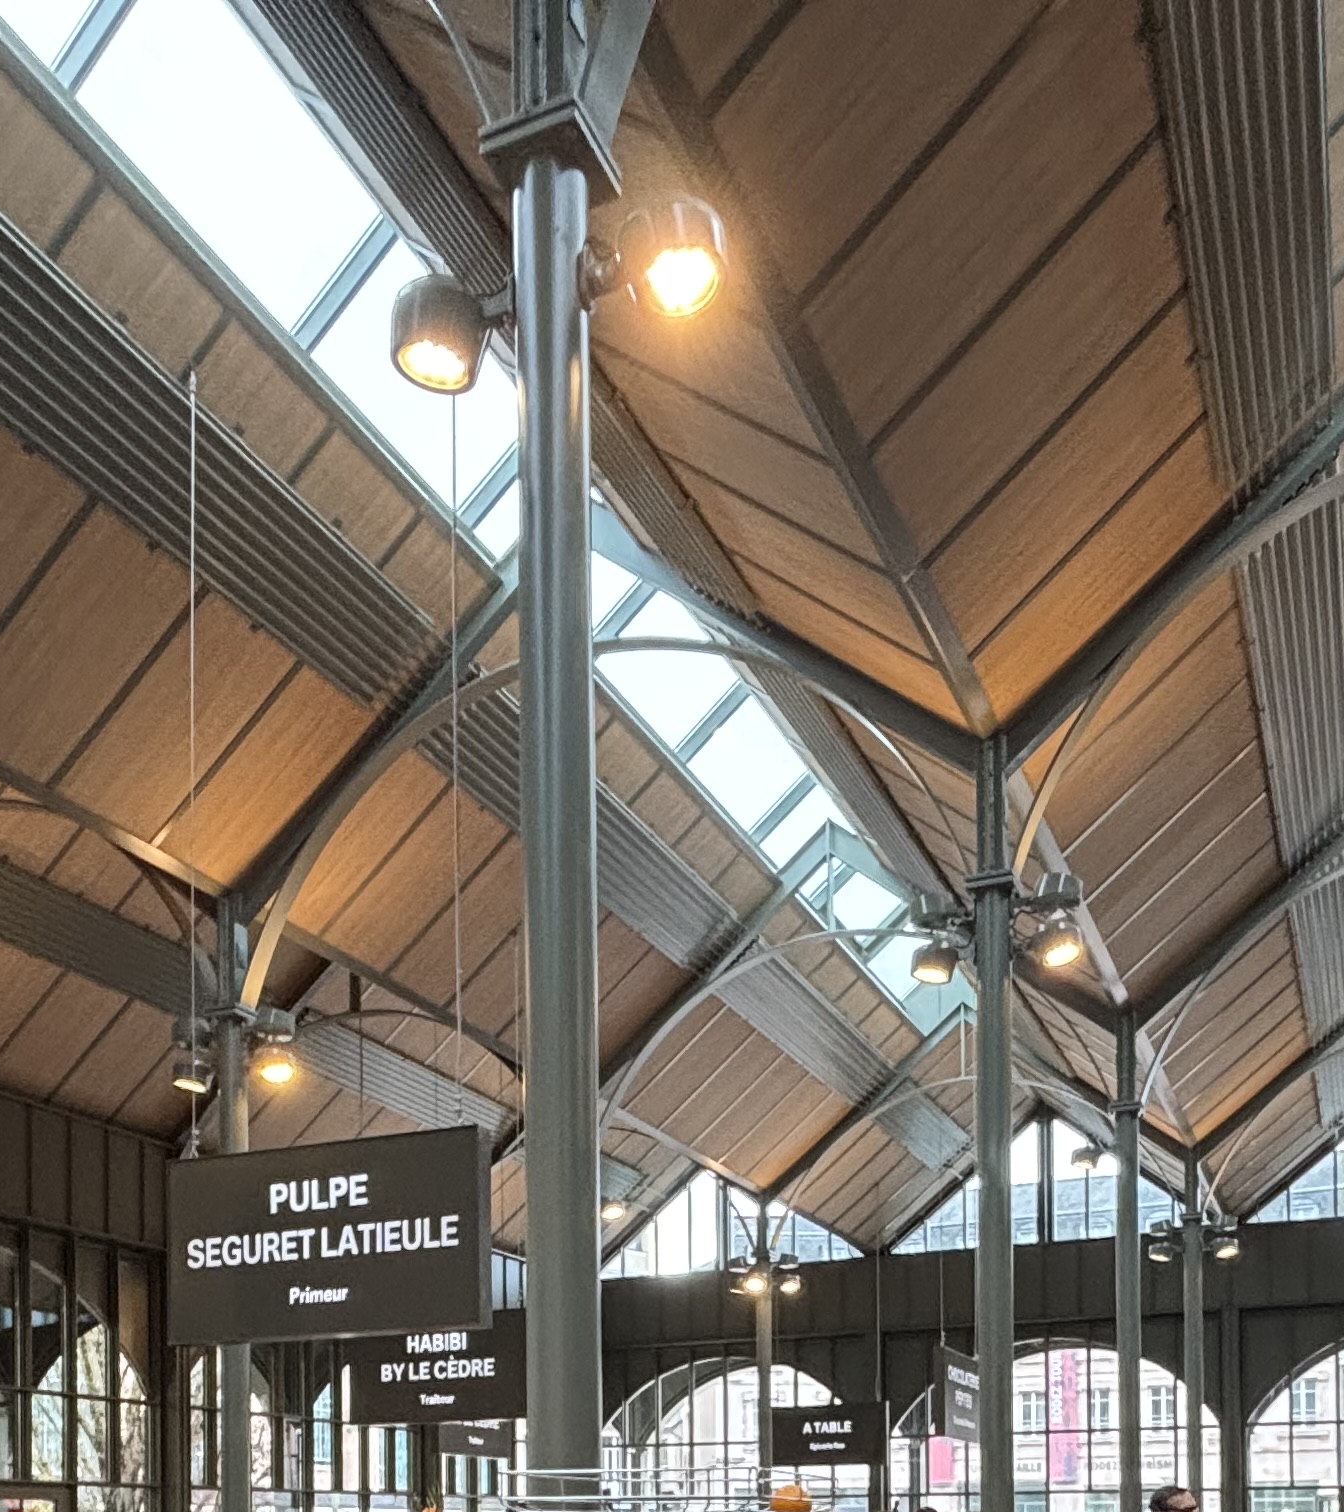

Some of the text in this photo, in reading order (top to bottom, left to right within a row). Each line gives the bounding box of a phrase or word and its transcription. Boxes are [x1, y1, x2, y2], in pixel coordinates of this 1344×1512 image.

[268, 1172, 369, 1215] PULPE
[187, 1214, 460, 1270] SEGURET LATIEULE
[288, 1285, 349, 1307] Primeur
[406, 1331, 467, 1354] HABIBI
[380, 1355, 496, 1383] BY LE CÈDRE
[802, 1419, 852, 1434] A TABLE
